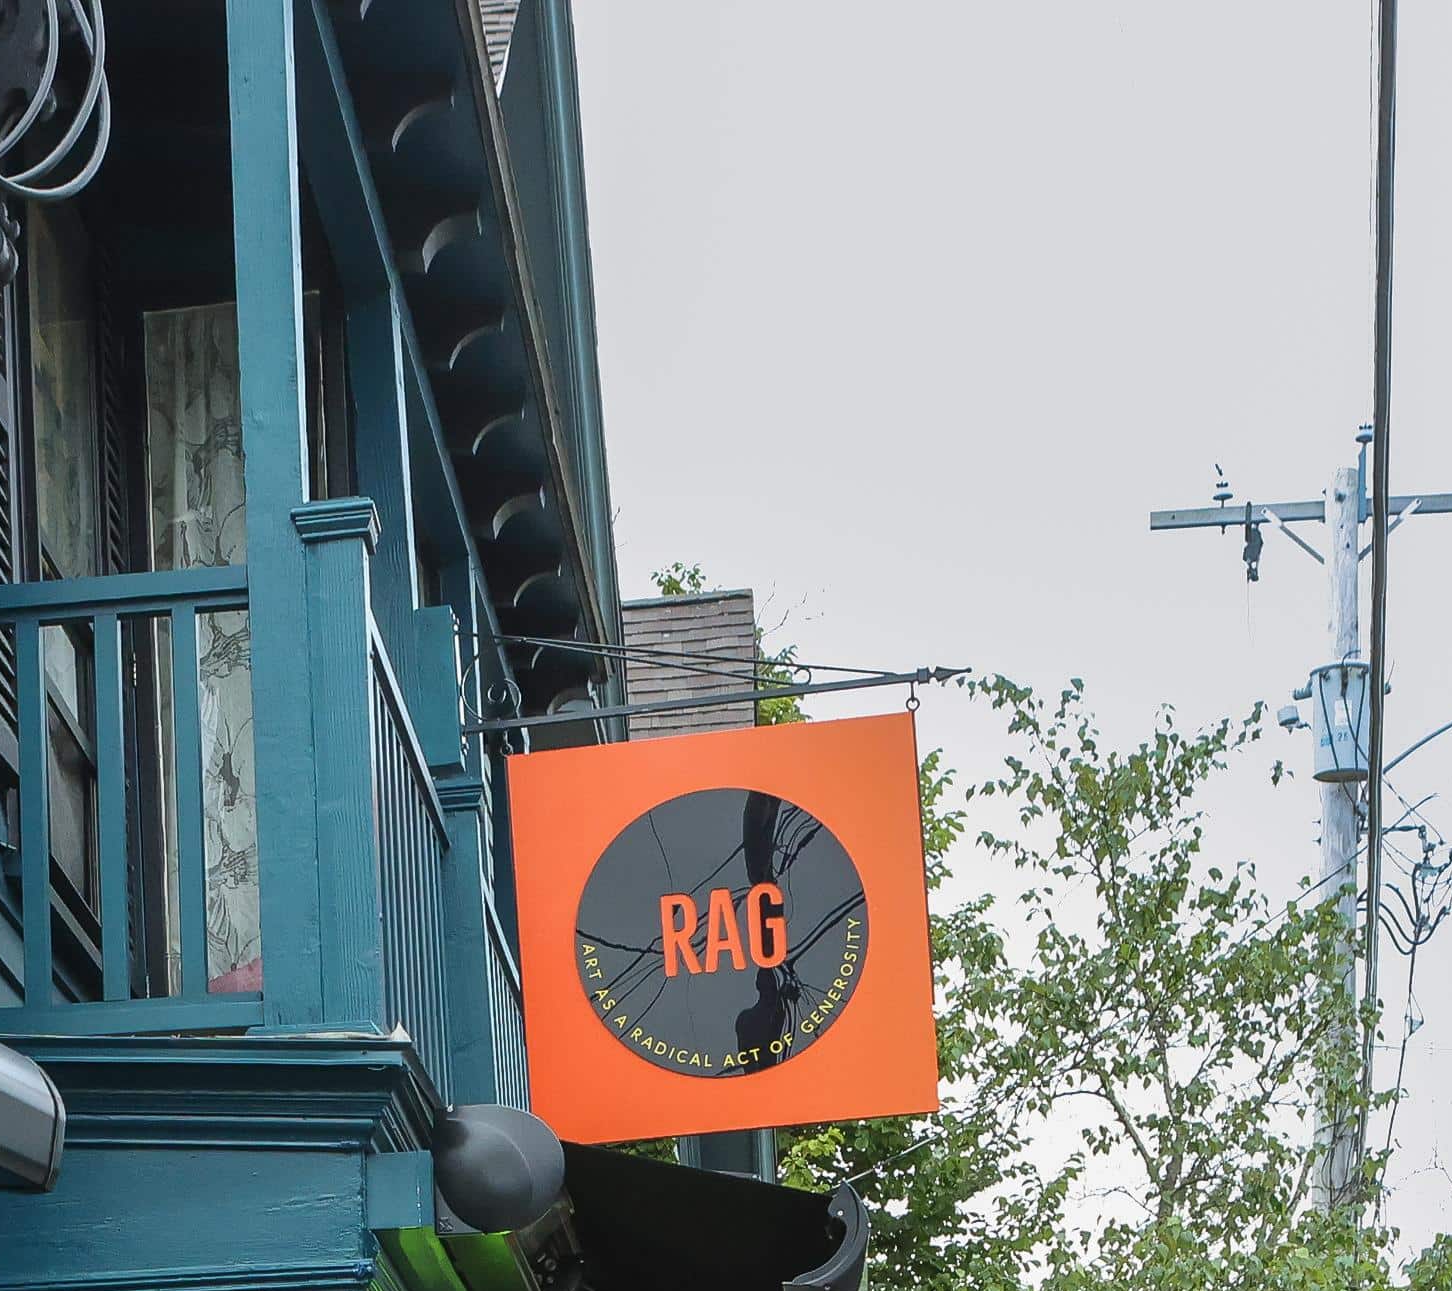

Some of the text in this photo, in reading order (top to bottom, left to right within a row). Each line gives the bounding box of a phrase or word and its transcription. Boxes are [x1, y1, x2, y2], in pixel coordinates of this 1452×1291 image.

[659, 883, 789, 978] RAG
[582, 918, 861, 1067] ART AS A RADICAL ACT OF GENEROSITY
